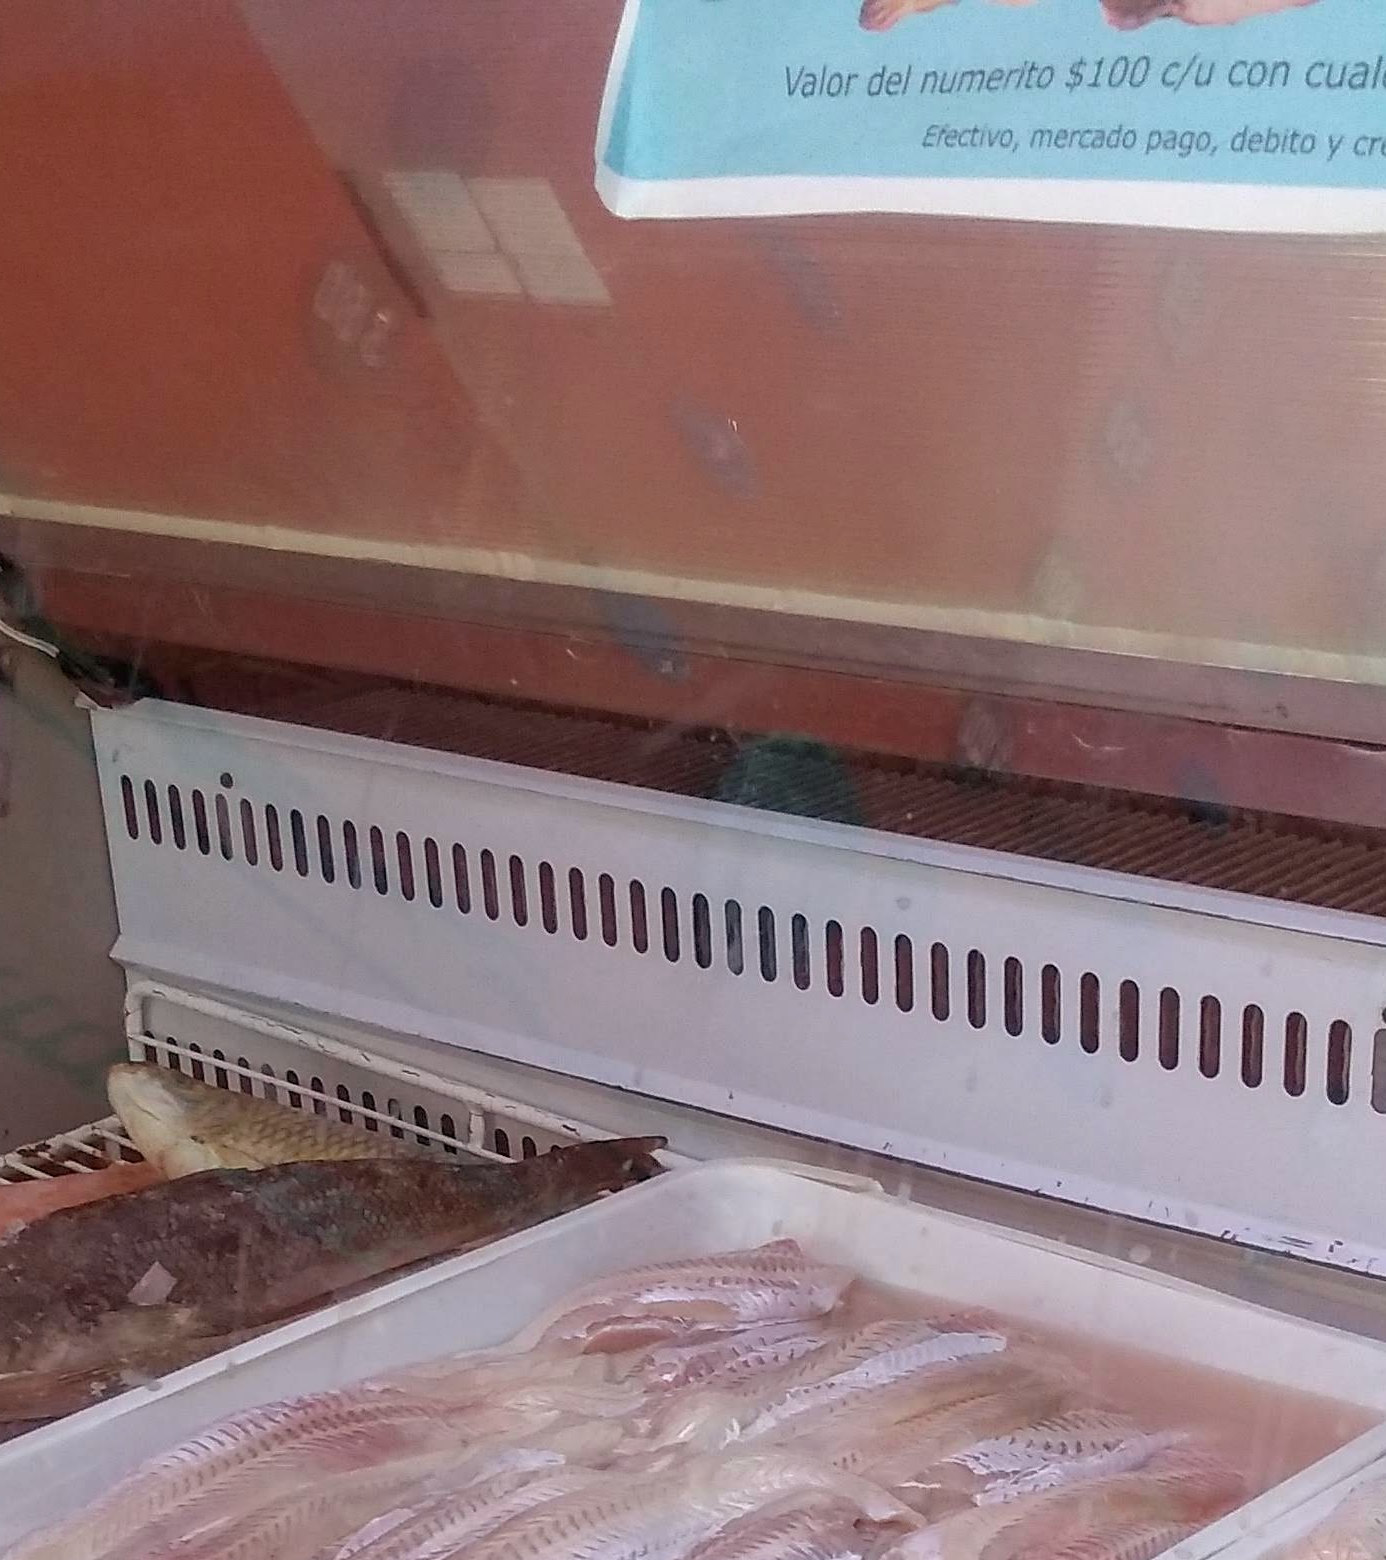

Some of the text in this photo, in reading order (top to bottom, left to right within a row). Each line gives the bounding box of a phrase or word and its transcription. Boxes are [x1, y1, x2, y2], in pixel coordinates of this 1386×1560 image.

[785, 65, 858, 98] Valor
[867, 64, 912, 97] del
[919, 60, 1055, 95] numerito
[1064, 55, 1151, 91] $100
[1160, 54, 1215, 92] c/u
[1227, 58, 1292, 89] con
[921, 123, 1019, 153] Efectivo,
[1029, 123, 1138, 151] mercado
[1145, 129, 1219, 158] pago,
[1230, 125, 1317, 156] debito
[1326, 133, 1345, 161] y
